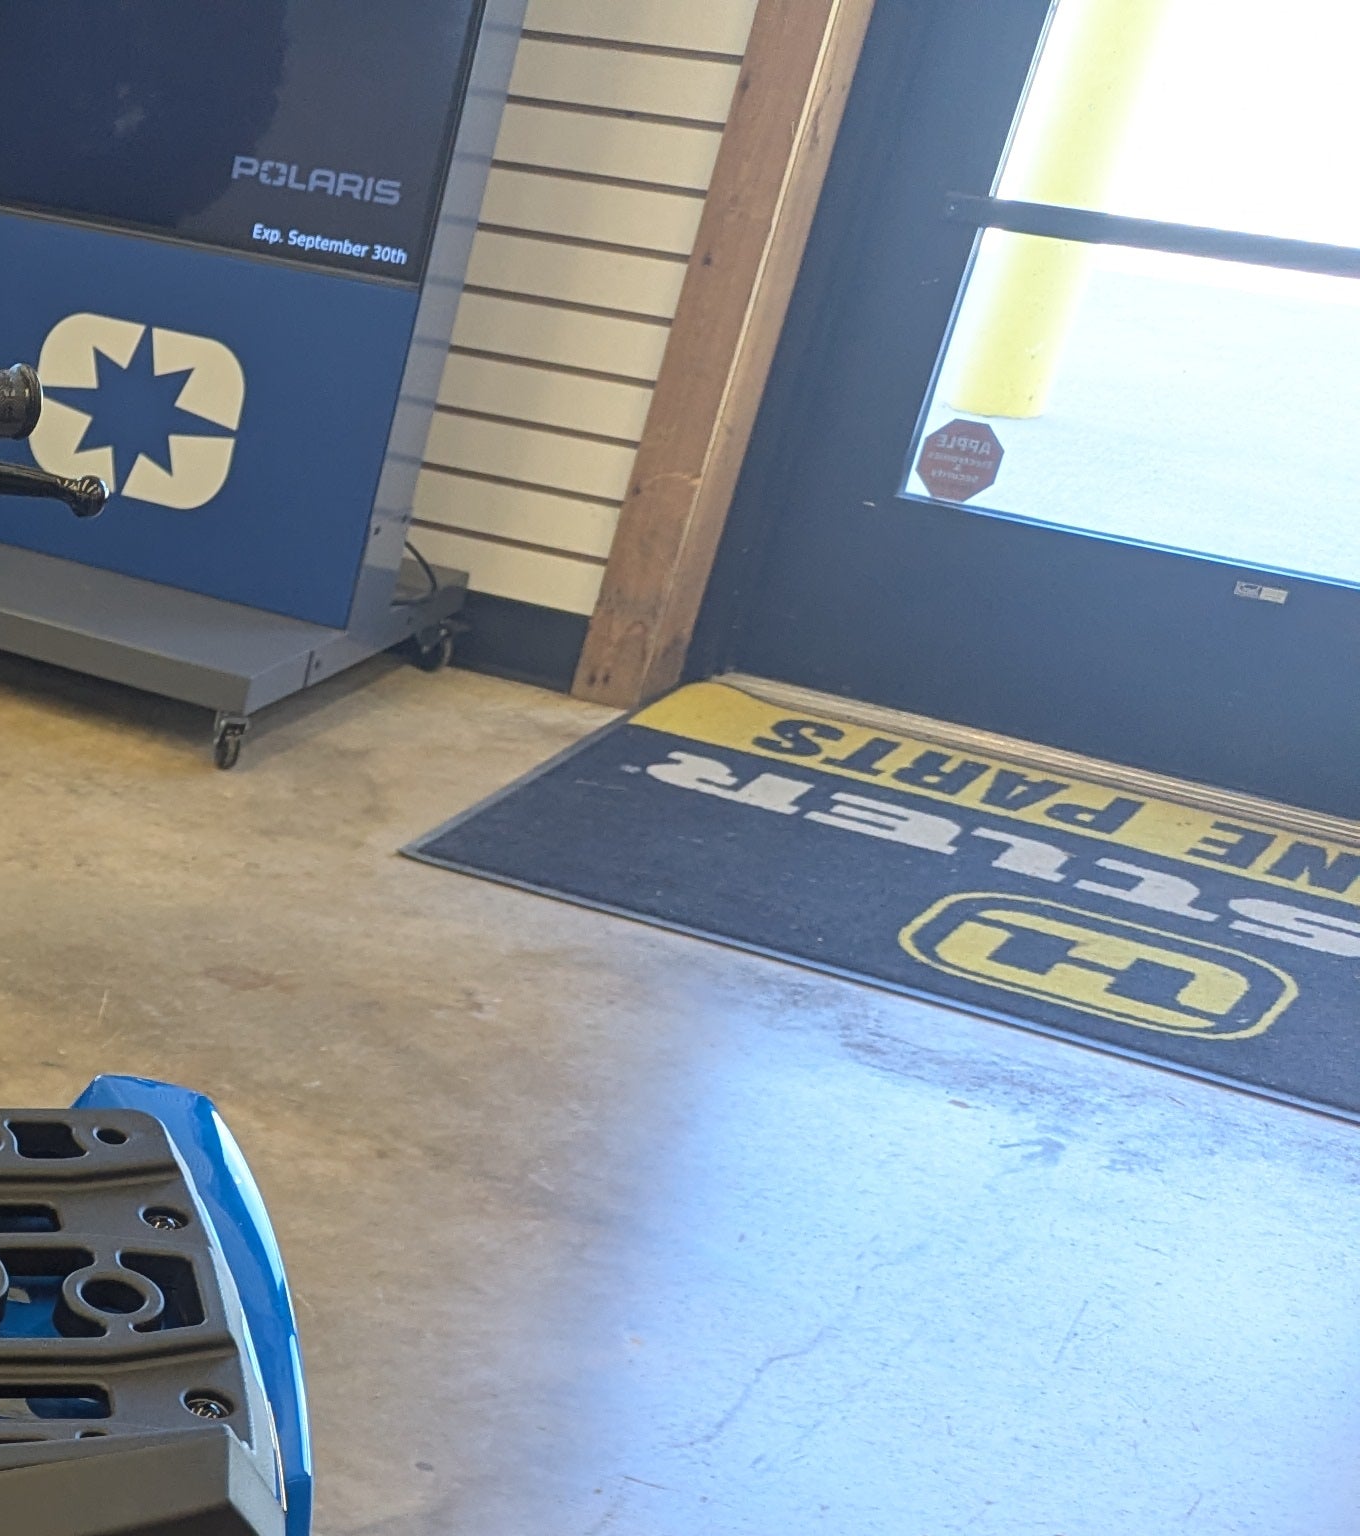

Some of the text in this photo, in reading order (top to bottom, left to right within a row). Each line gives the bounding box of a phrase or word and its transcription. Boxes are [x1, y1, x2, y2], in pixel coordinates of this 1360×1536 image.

[231, 156, 401, 206] POLARIS
[252, 223, 408, 264] Exp. September 30th
[646, 751, 1360, 957] STLER
[753, 718, 1360, 894] NE PARTS
